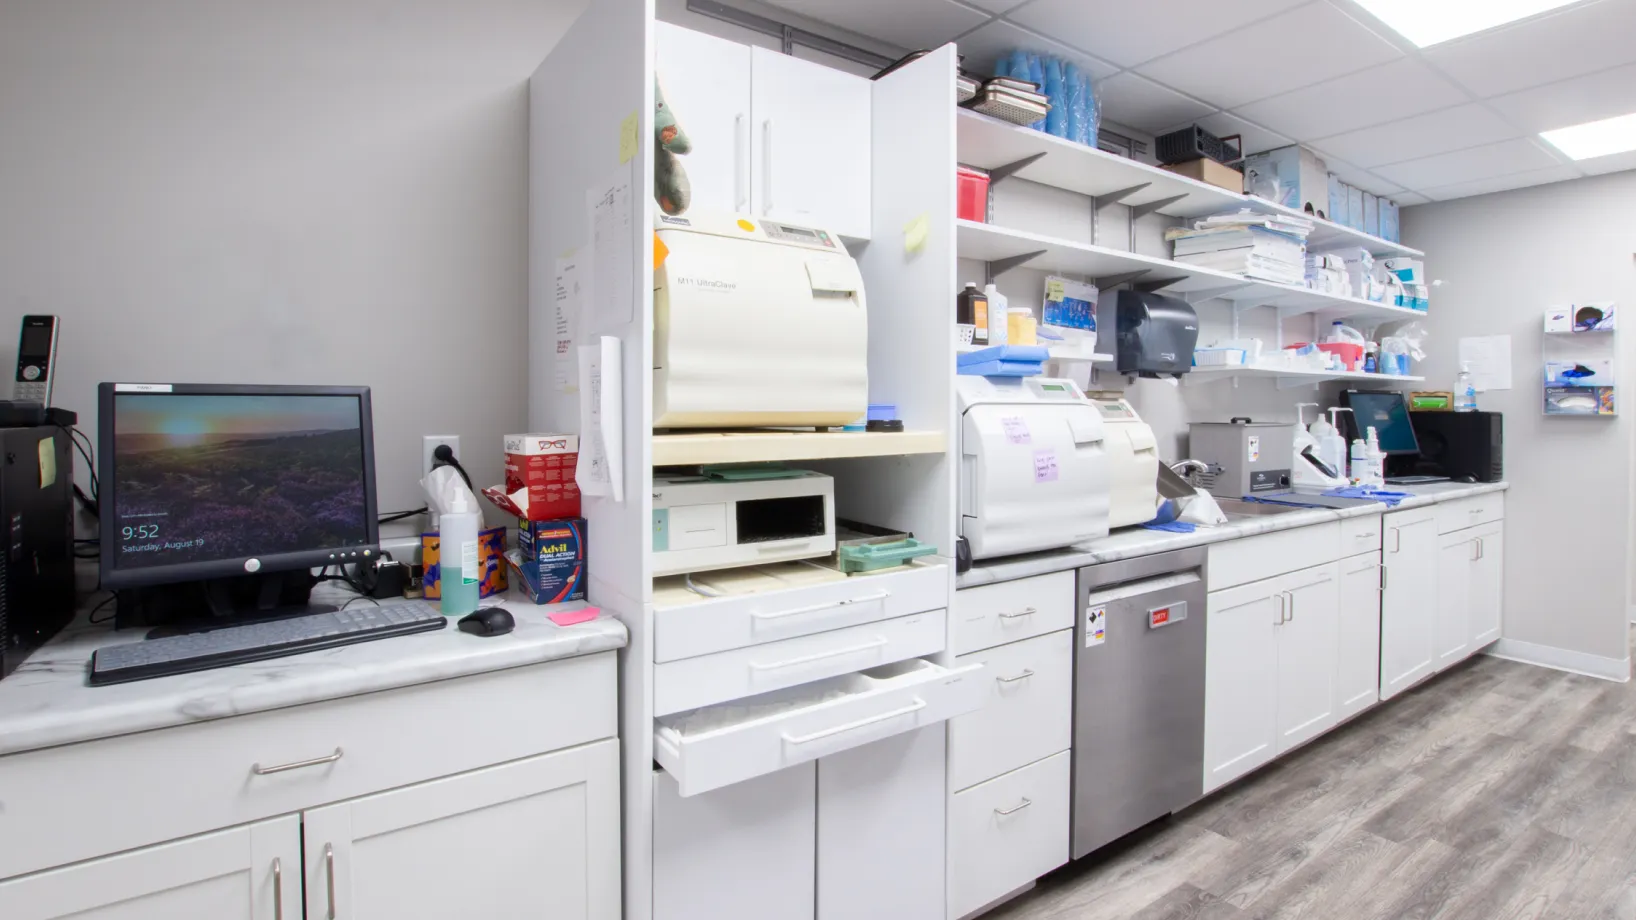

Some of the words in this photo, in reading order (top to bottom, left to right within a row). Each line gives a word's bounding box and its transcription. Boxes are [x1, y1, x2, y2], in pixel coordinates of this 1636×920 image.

[677, 277, 694, 285] M11
[697, 279, 736, 289] UltraClave
[122, 524, 159, 541] 9:52
[122, 543, 161, 553] Saturday,
[164, 541, 193, 550] August
[195, 538, 204, 547] 19
[540, 543, 567, 554] Advil
